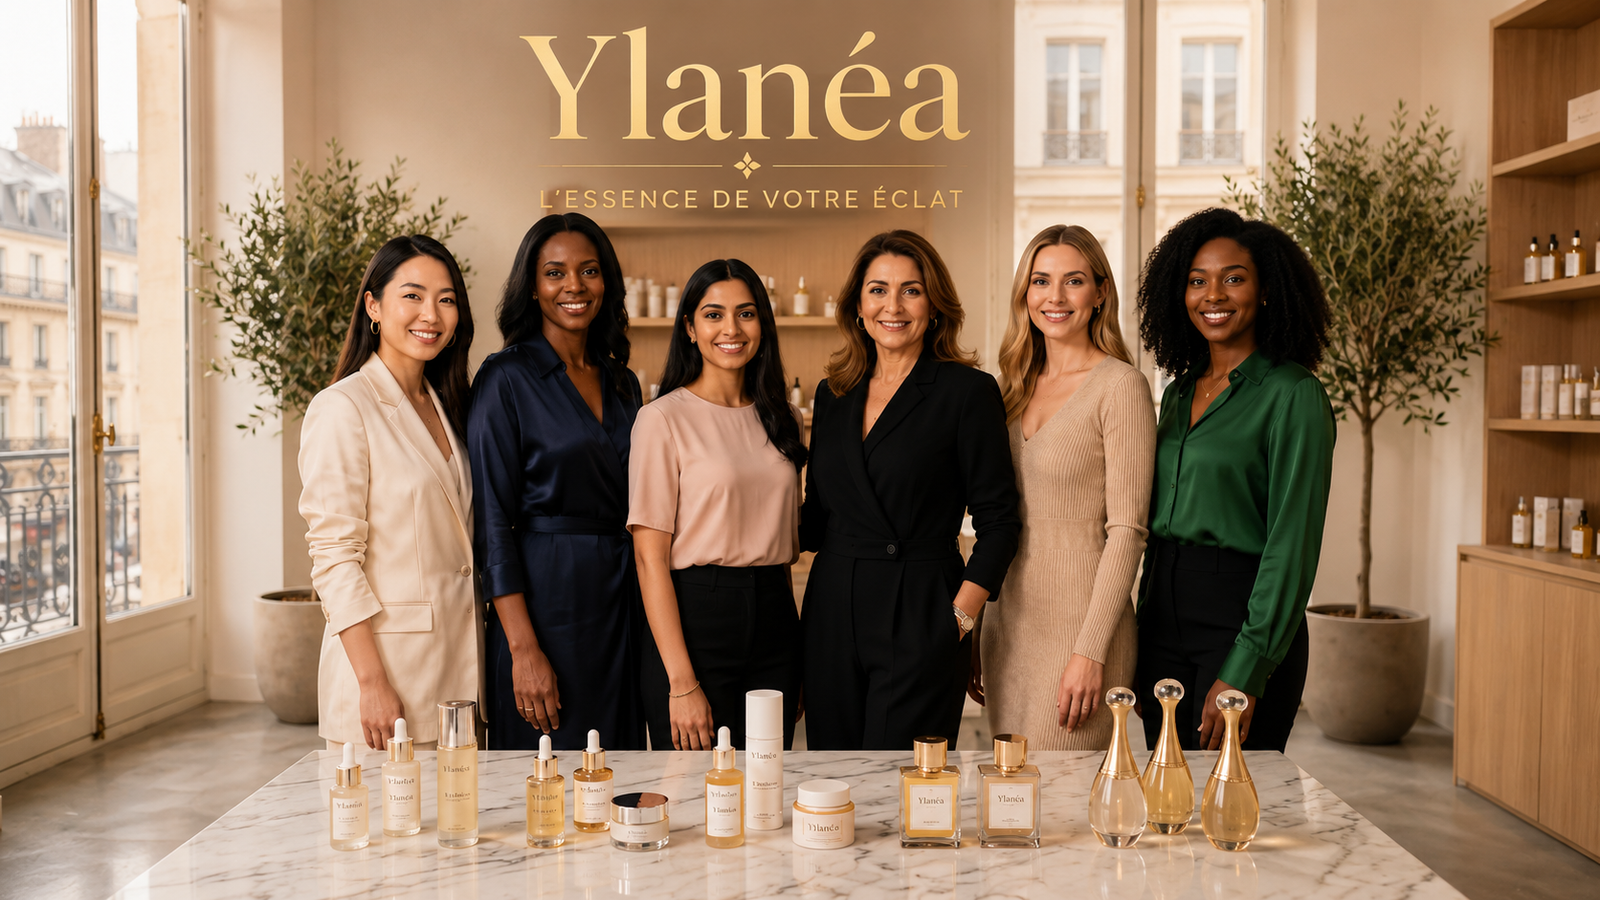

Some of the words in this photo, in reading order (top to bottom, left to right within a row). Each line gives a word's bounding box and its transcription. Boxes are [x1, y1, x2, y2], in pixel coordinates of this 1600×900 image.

[519, 26, 971, 141] Ylanéa
[540, 189, 698, 208] L'ESSENCE
[713, 190, 749, 208] DE
[763, 190, 859, 208] VOTRE
[873, 185, 963, 208] ÉCLAT
